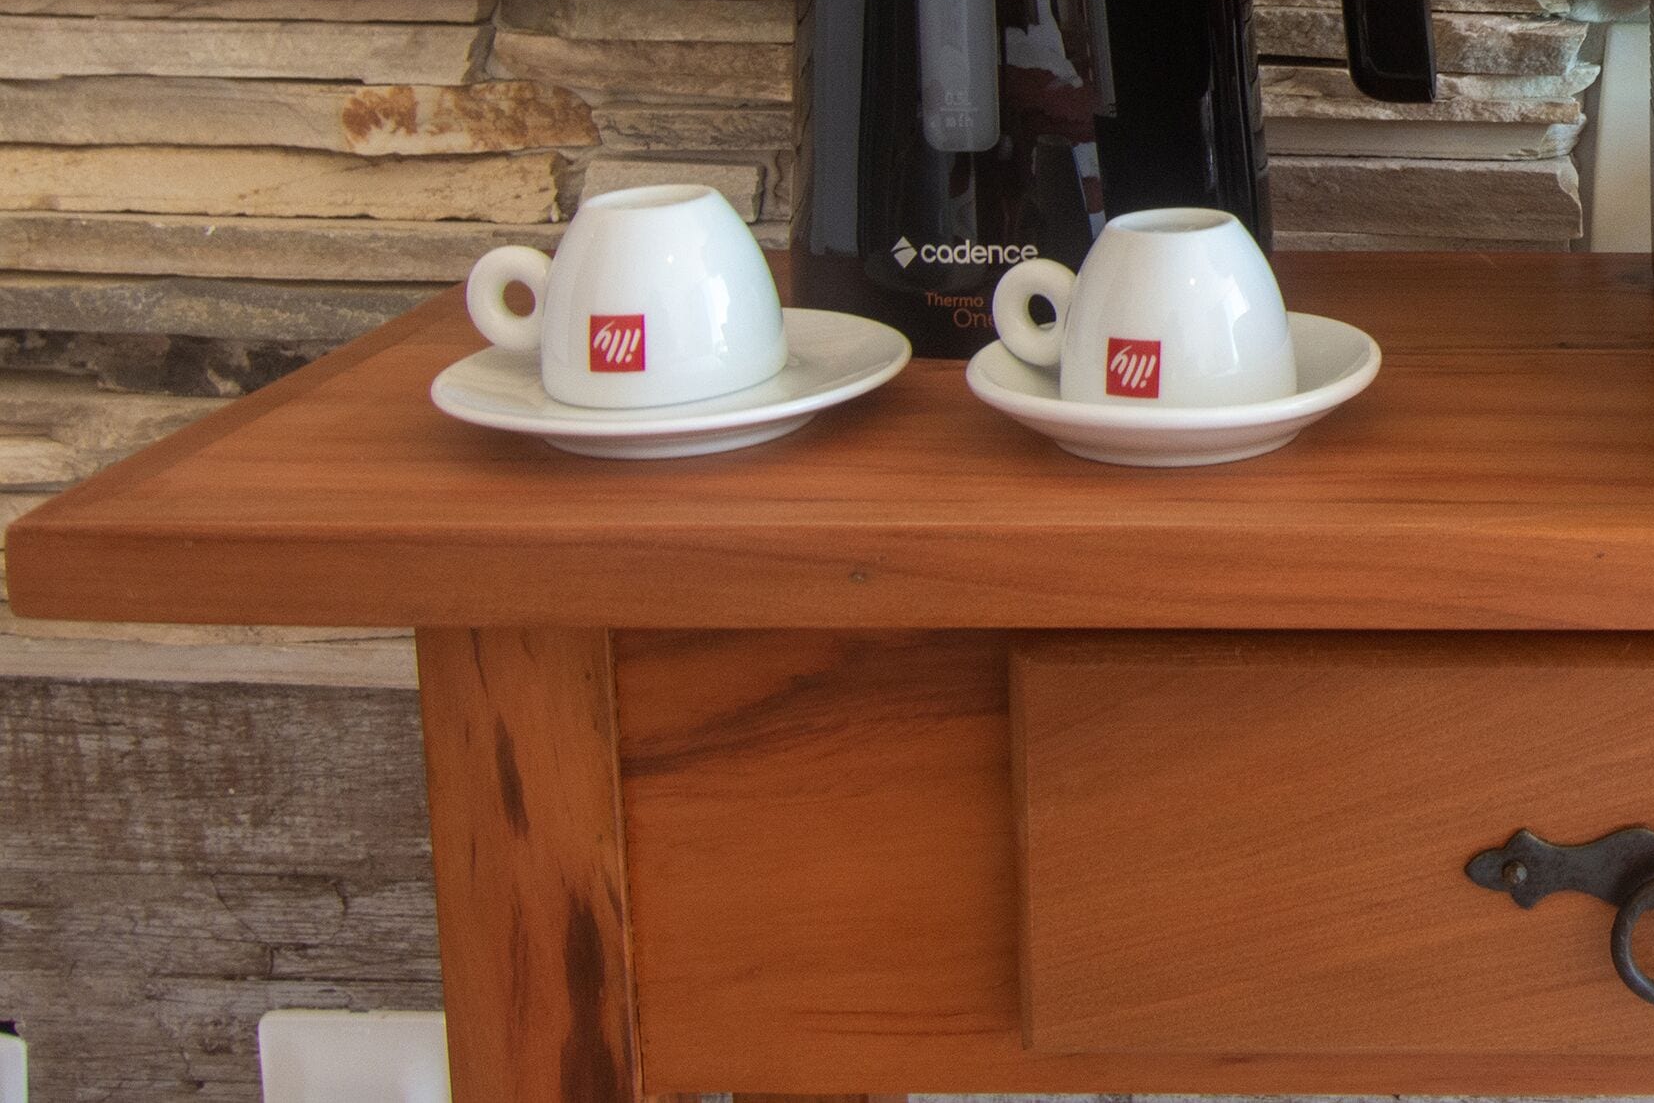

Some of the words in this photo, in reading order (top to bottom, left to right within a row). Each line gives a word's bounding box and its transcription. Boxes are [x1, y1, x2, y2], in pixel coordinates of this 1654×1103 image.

[920, 239, 1039, 264] cadence
[926, 291, 984, 308] Thermo
[953, 307, 993, 328] On
[593, 320, 641, 364] illy
[1110, 345, 1157, 389] illy
